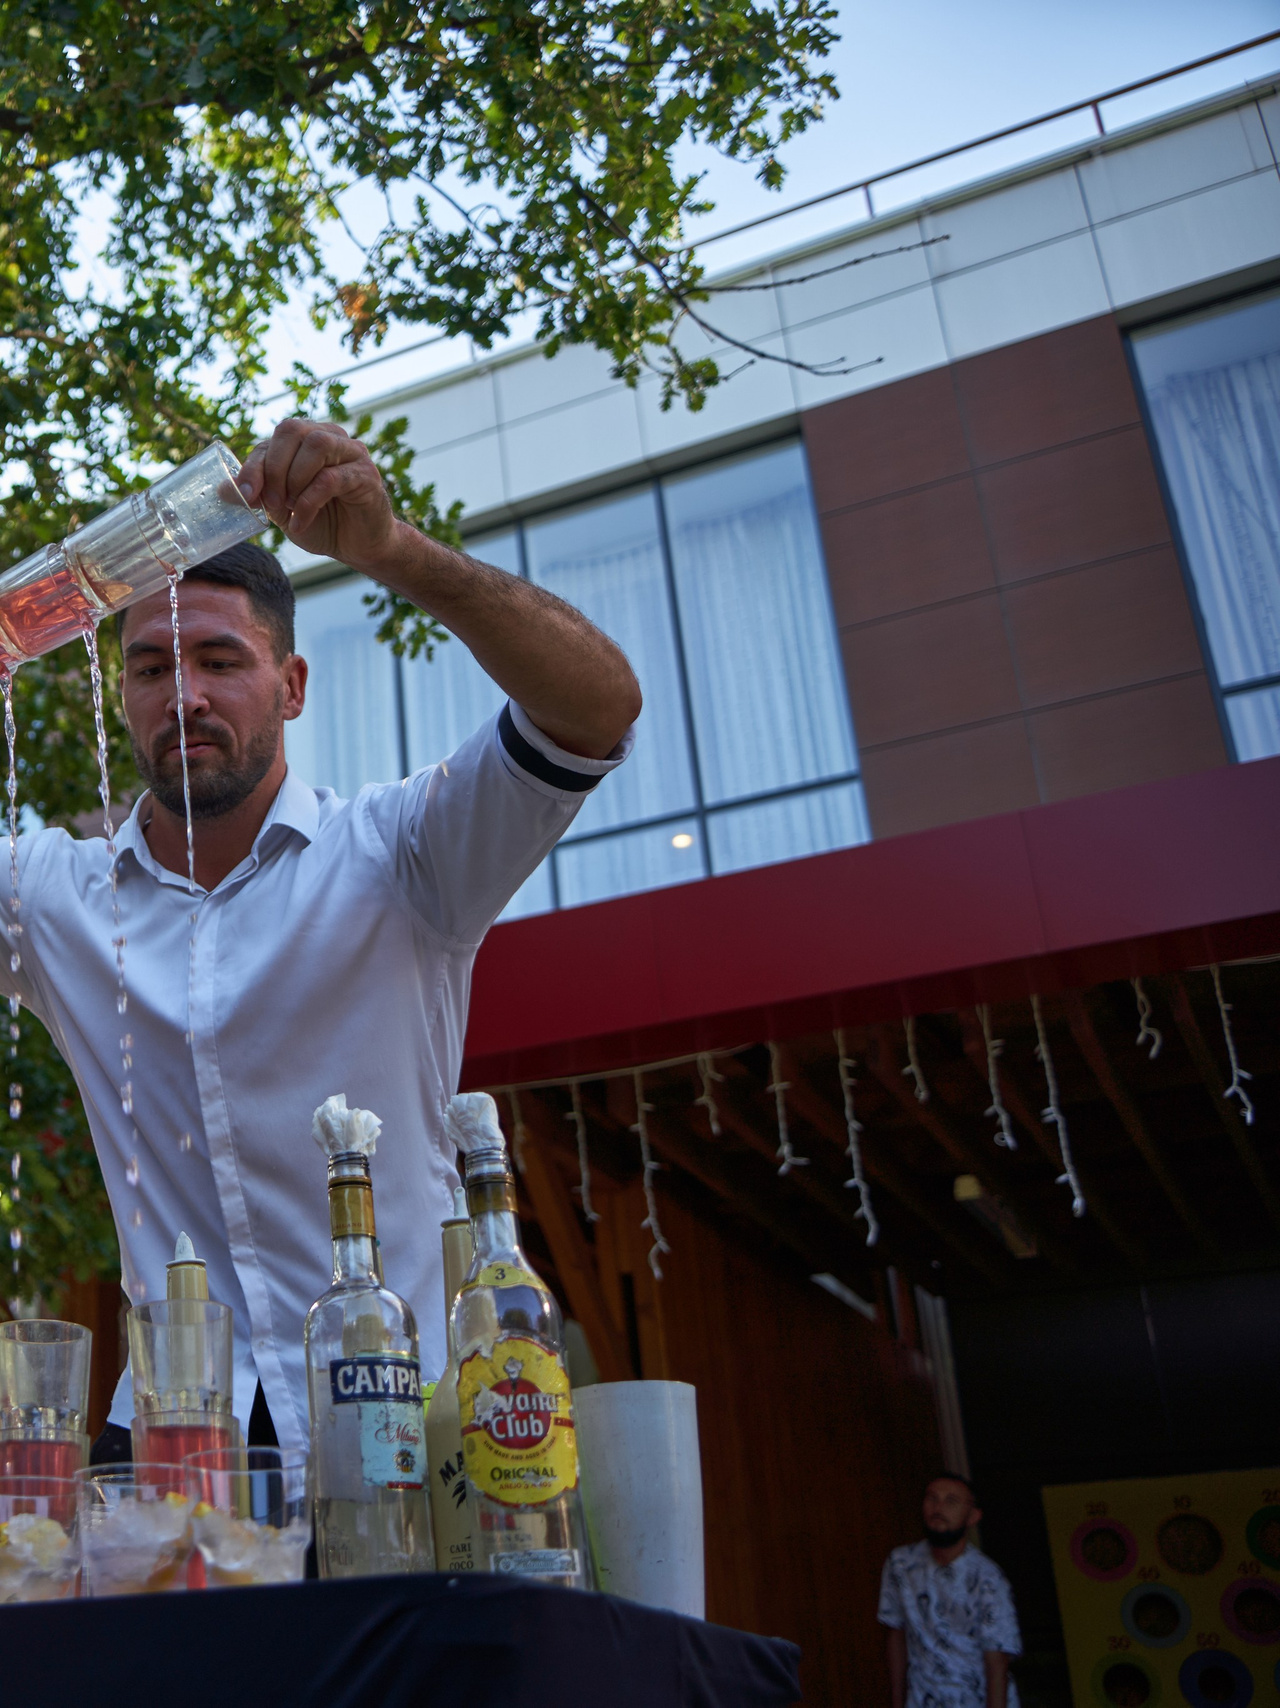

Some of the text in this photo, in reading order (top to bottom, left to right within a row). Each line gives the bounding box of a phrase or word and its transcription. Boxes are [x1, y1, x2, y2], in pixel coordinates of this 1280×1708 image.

[495, 1268, 506, 1280] 3
[337, 1365, 421, 1397] CAMPA
[490, 1392, 558, 1412] vana
[492, 1414, 544, 1439] Club
[439, 1450, 464, 1487] MA
[450, 1543, 472, 1554] CARI
[1137, 1566, 1160, 1581] 40
[1237, 1561, 1261, 1575] 40
